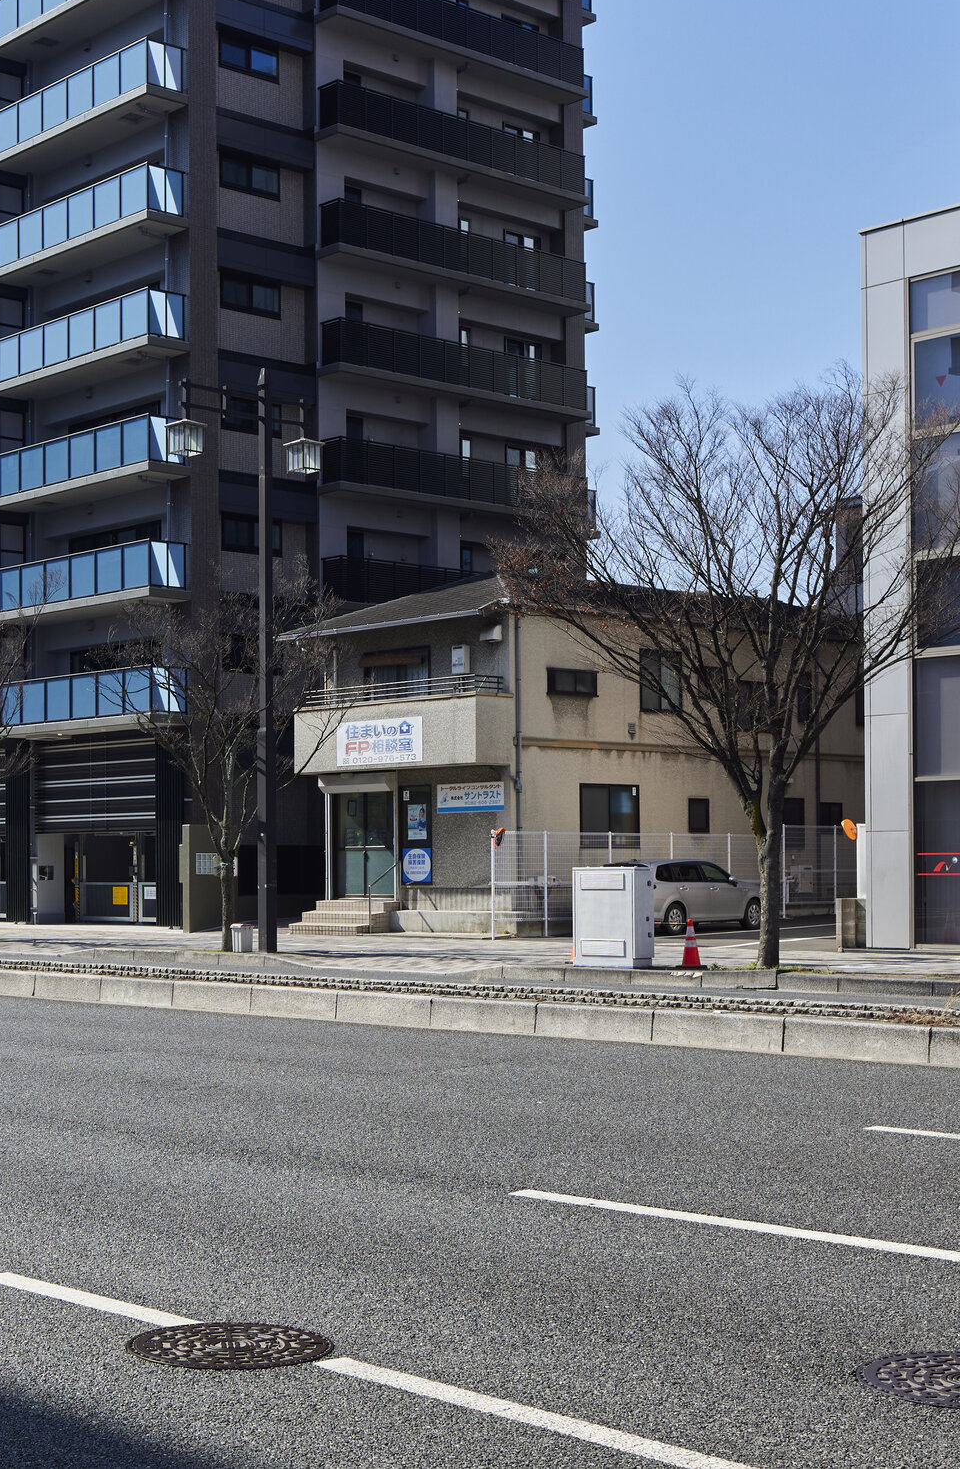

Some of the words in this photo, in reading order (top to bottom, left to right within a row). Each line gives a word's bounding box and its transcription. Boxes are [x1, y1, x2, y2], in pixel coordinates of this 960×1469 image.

[345, 724, 398, 740] 住まいの
[345, 737, 413, 755] FP相談室
[464, 790, 501, 800] サントラスト
